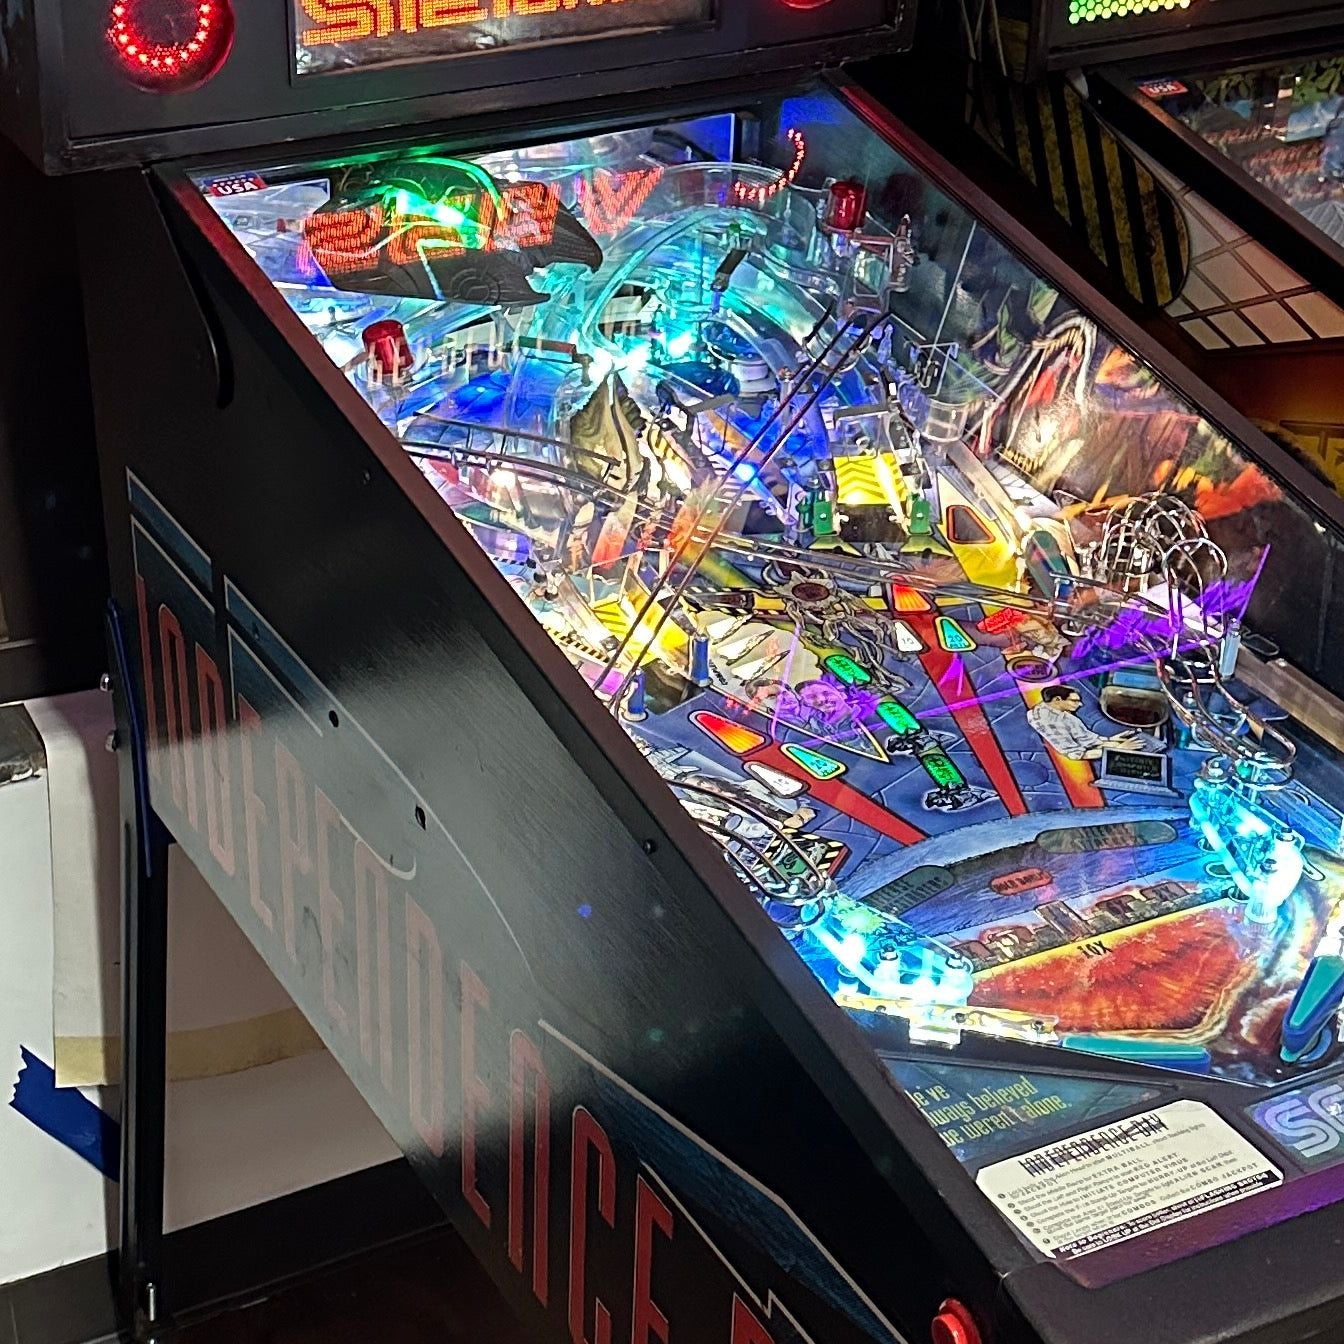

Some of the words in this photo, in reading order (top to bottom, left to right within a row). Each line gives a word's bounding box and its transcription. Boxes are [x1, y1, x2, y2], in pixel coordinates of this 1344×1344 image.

[216, 181, 258, 195] USA
[966, 1074, 1039, 1111] believed
[1020, 1093, 1073, 1120] alone.
[1016, 1124, 1140, 1177] INDEPENDENCE
[1128, 1112, 1171, 1137] DAY
[1090, 1165, 1120, 1178] EXTRA
[1119, 1156, 1144, 1168] BALL
[1150, 1152, 1180, 1165] ALERT
[1114, 1166, 1163, 1186] COMPUTER
